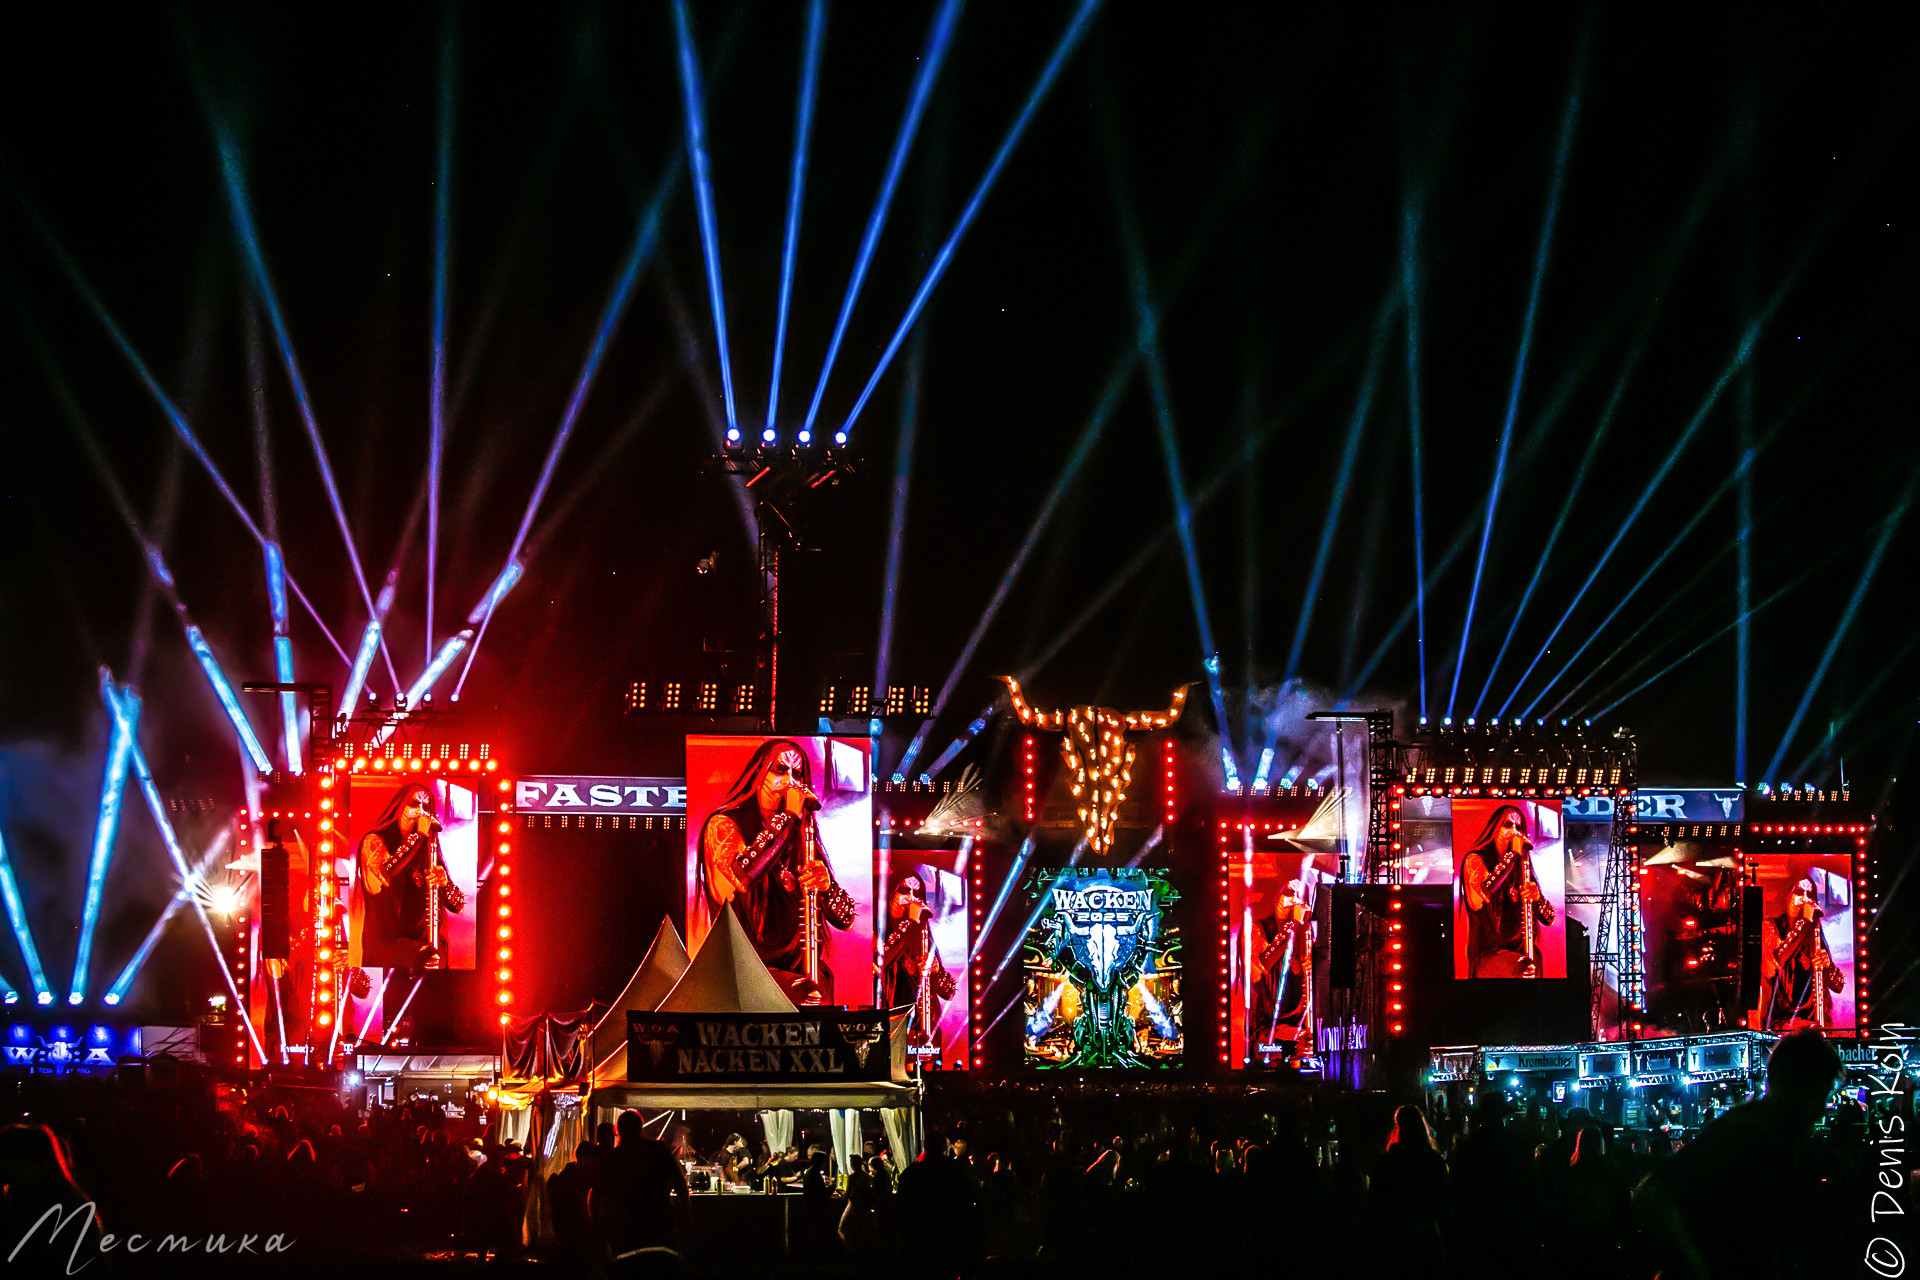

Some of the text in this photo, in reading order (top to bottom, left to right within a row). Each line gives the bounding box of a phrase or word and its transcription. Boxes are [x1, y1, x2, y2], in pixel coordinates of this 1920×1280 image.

[516, 781, 687, 807] FASTE
[1562, 795, 1688, 818] RDER
[1052, 888, 1154, 911] WACKEN
[1076, 911, 1130, 922] 2025
[696, 1021, 822, 1046] WACKEN
[907, 1045, 941, 1054] Krmbacher
[1258, 1043, 1283, 1053] Krombac
[1838, 1043, 1877, 1062] bacher
[676, 1048, 845, 1074] NACKEN XXL
